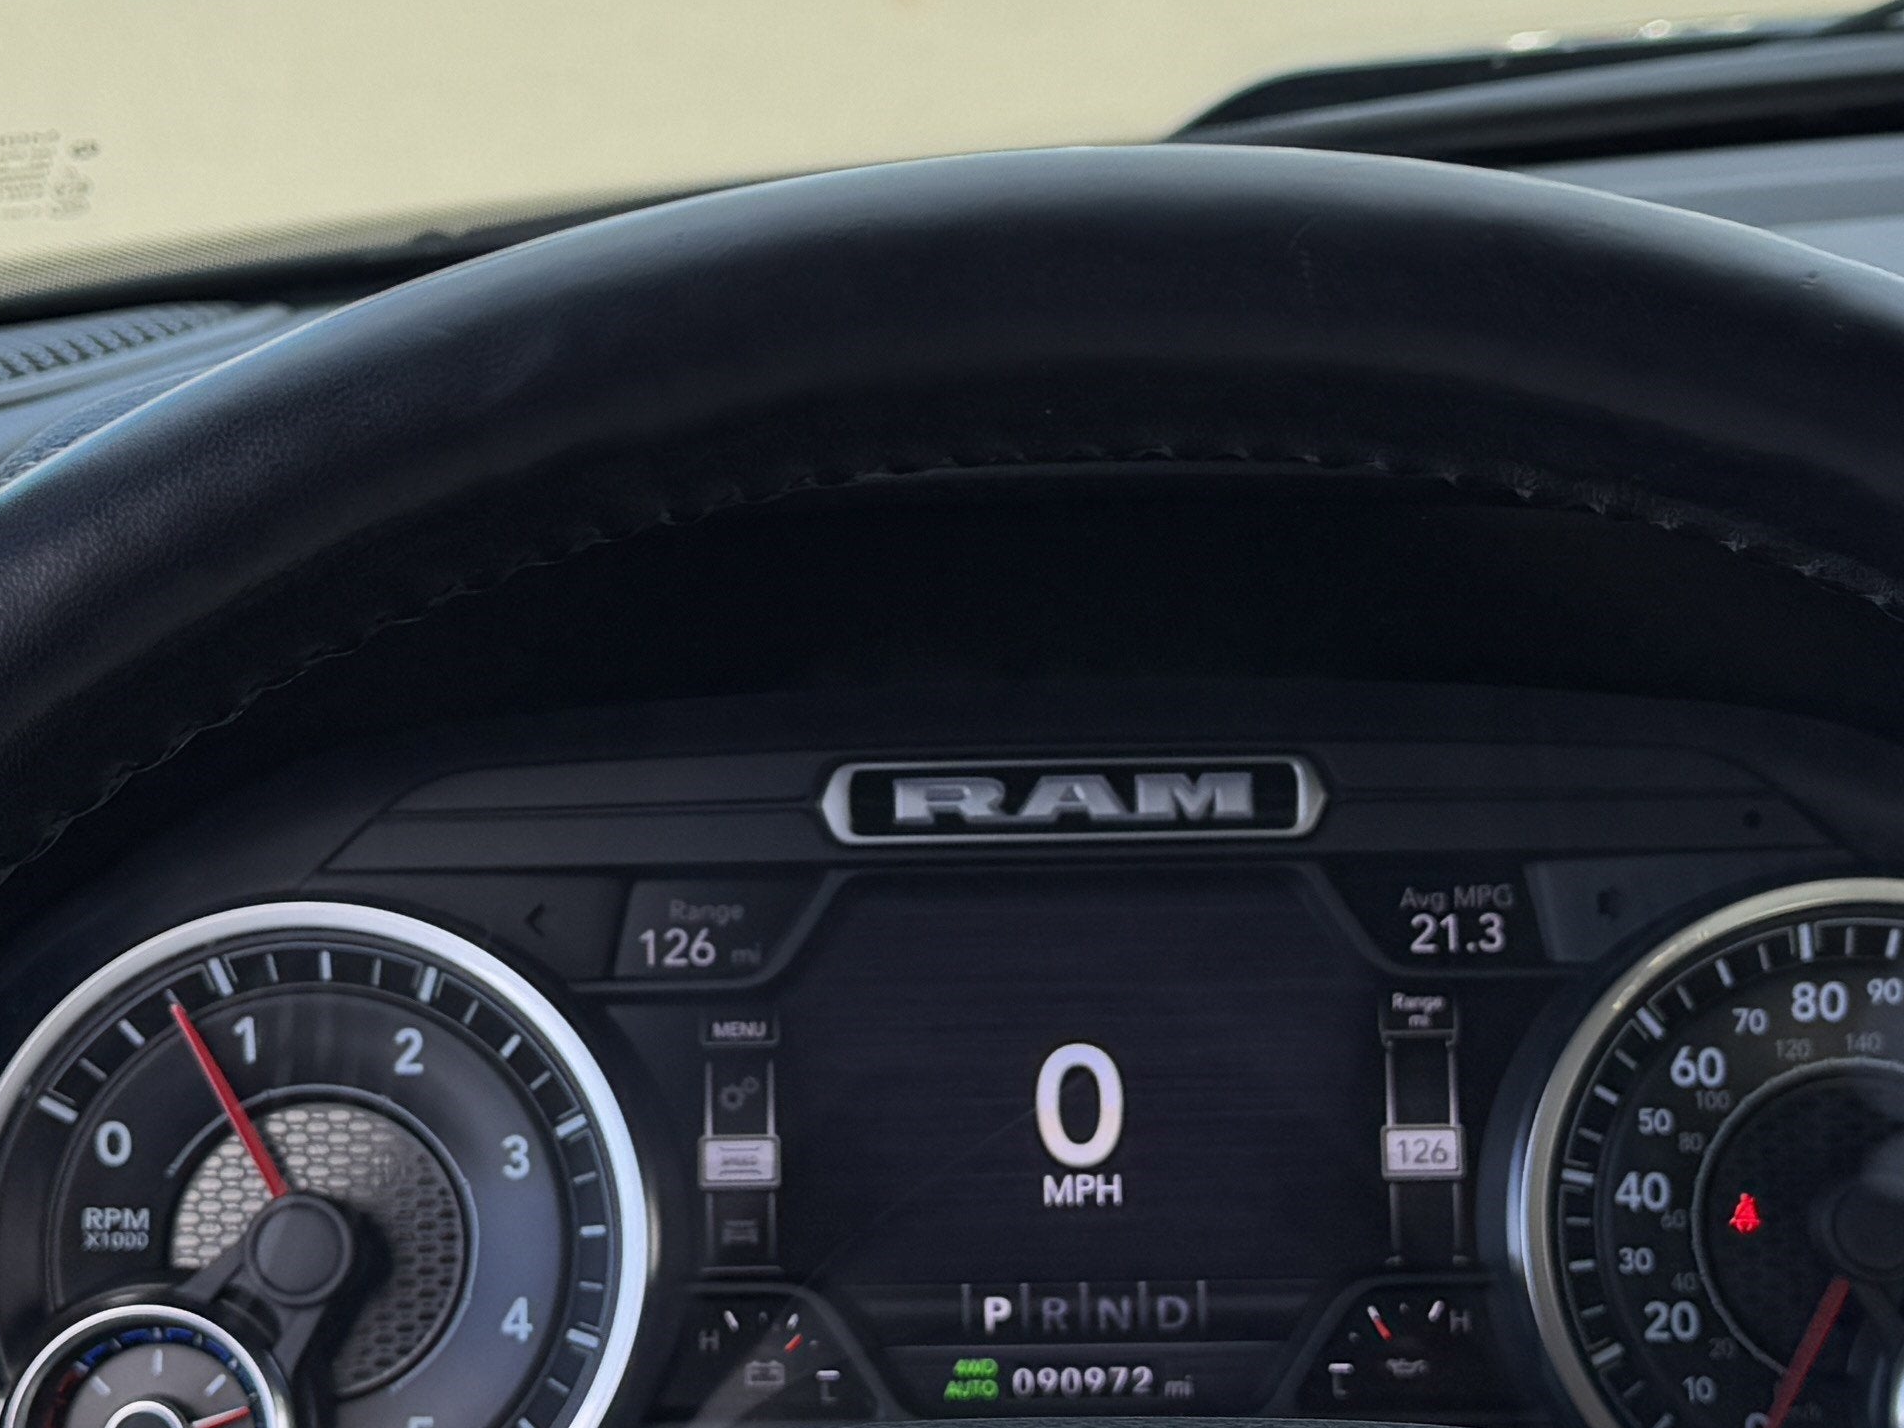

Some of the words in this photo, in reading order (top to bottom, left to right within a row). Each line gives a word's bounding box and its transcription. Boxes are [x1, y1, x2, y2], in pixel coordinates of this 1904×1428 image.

[894, 773, 1253, 824] RAM
[668, 899, 745, 926] Range
[1399, 886, 1446, 913] Avg
[1453, 883, 1514, 909] MPG
[638, 927, 717, 968] 126
[1410, 912, 1506, 954] 21.3
[1391, 992, 1445, 1014] Range
[1791, 980, 1848, 1022] 80
[1867, 977, 1904, 1005] 90
[233, 1016, 258, 1064] 1
[711, 1020, 768, 1041] MENU
[1732, 1008, 1769, 1036] 70
[392, 1027, 427, 1078] 2
[1670, 1045, 1727, 1089] 60
[1035, 1042, 1124, 1169] 0
[1638, 1107, 1674, 1136] 50
[96, 1119, 133, 1169] 0
[500, 1134, 532, 1181] 3
[1396, 1137, 1448, 1165] 126
[1043, 1173, 1123, 1207] MPH
[1614, 1171, 1672, 1213] 40
[81, 1206, 151, 1231] RPM
[1618, 1246, 1655, 1274] 30
[499, 1296, 535, 1342] 4
[983, 1296, 1013, 1335] P
[1041, 1296, 1069, 1329] R
[1099, 1295, 1132, 1330] N
[1156, 1295, 1191, 1329] D
[1644, 1300, 1700, 1343] 20
[944, 1380, 999, 1401] AUTO
[1012, 1366, 1154, 1398] 090972
[1164, 1374, 1194, 1398] mi
[1682, 1375, 1716, 1405] 10
